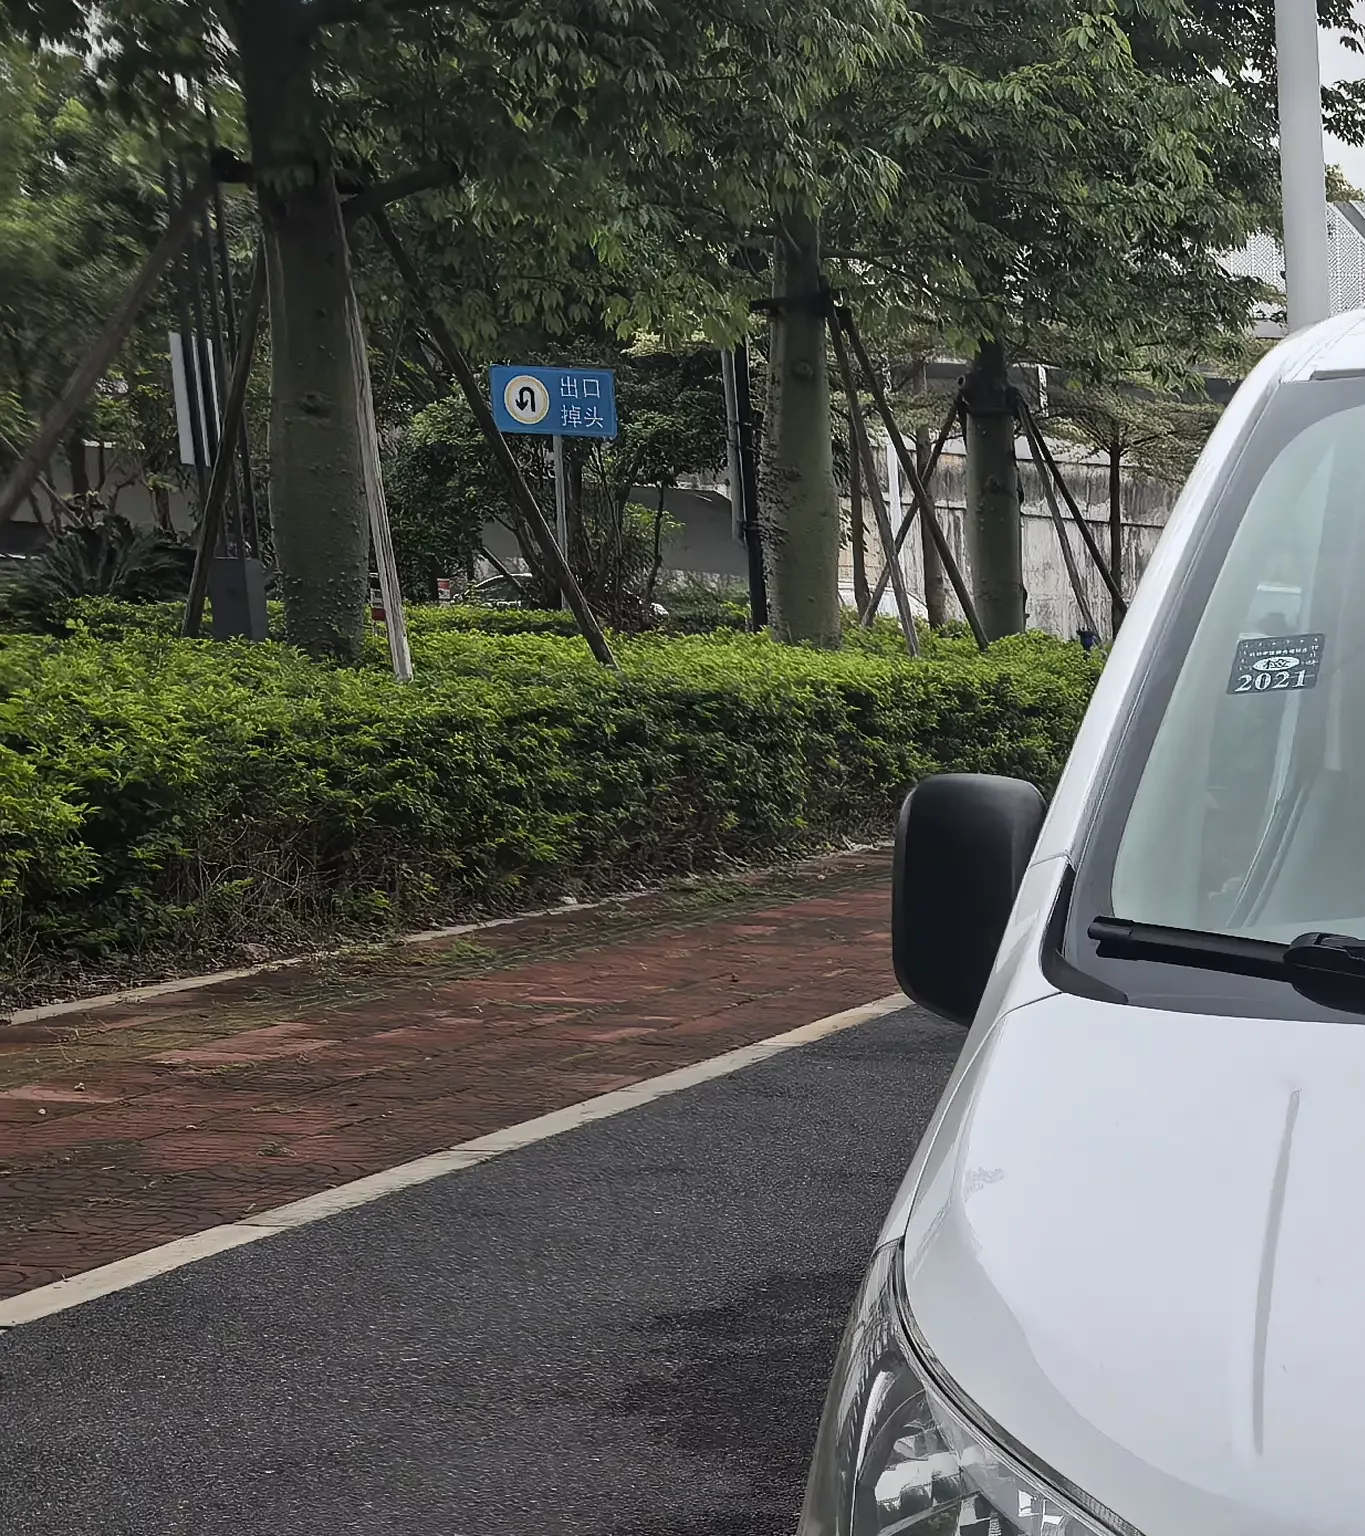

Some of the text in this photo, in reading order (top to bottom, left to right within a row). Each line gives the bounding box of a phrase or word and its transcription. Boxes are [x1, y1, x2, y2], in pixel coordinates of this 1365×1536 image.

[560, 375, 600, 399] 出口
[560, 404, 604, 429] 掉头
[1235, 669, 1306, 692] 2021
